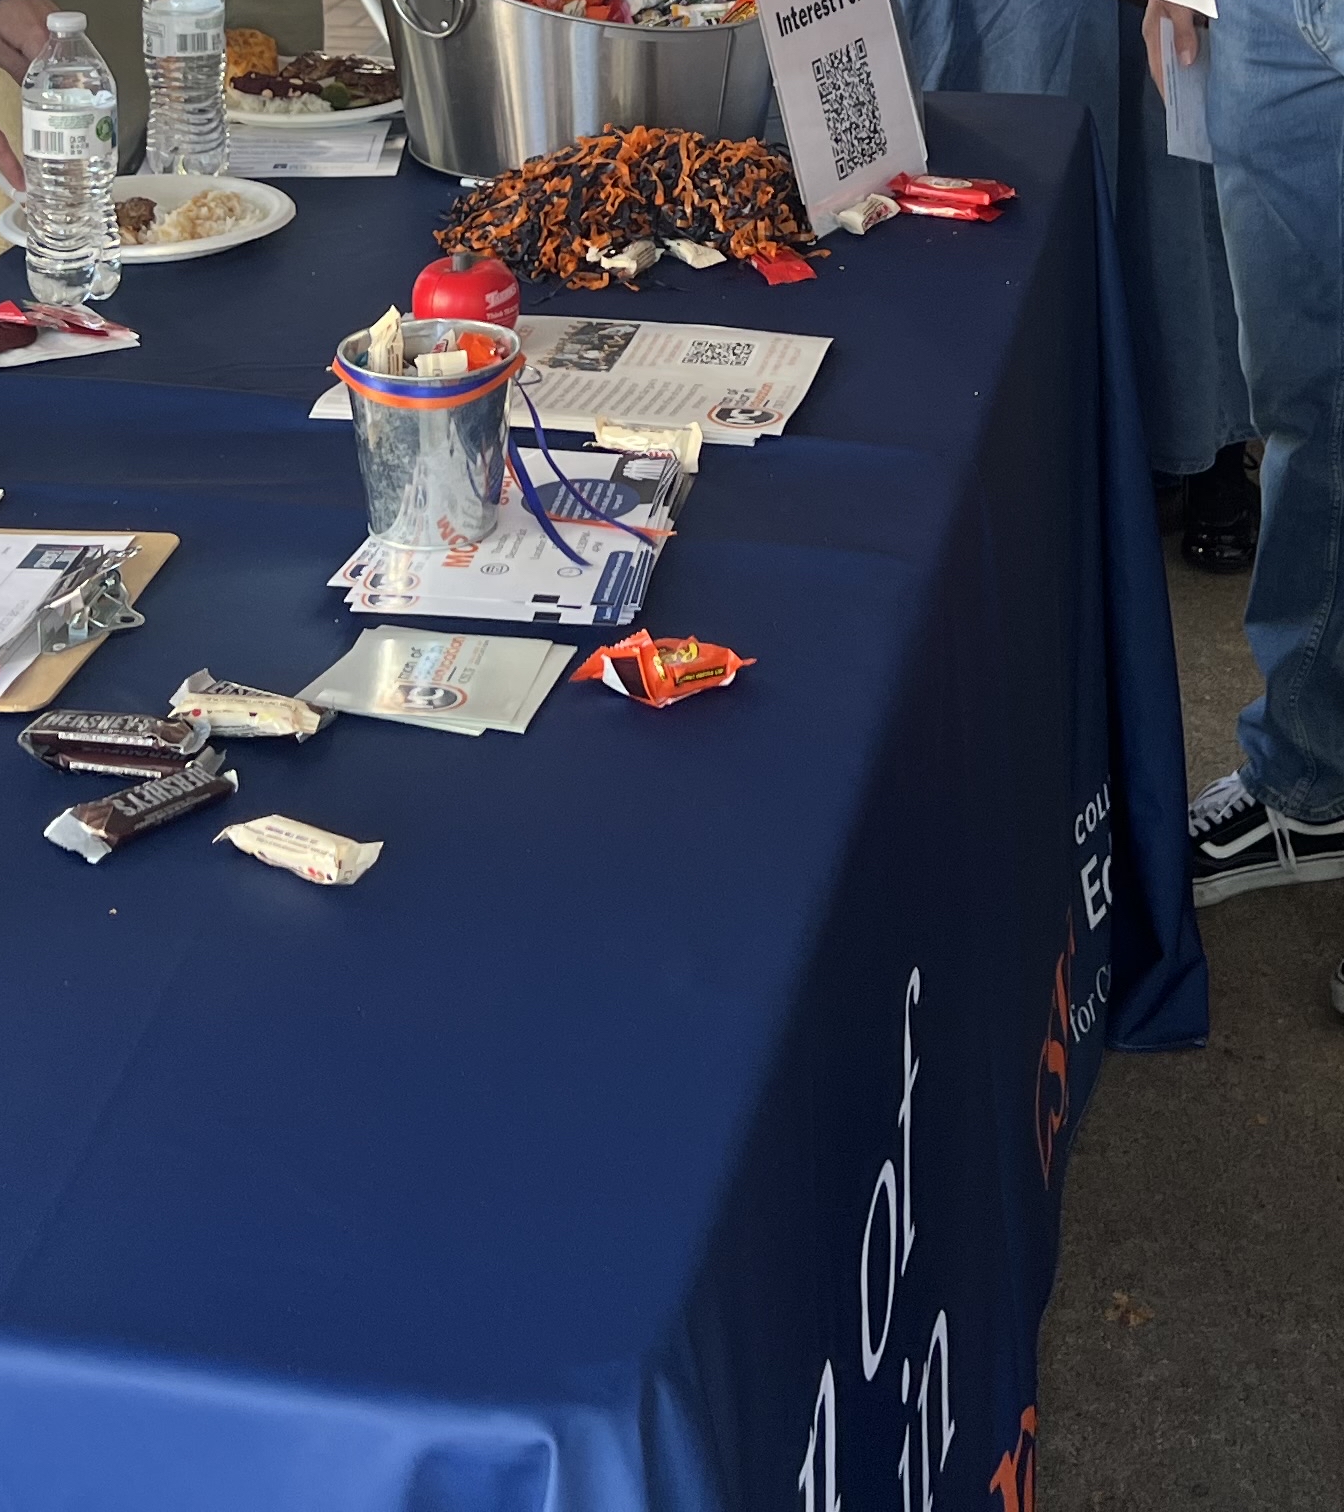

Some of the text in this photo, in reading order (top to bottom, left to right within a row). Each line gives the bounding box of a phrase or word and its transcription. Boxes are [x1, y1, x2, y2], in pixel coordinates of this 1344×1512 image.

[43, 713, 150, 733] HERSHEY'S
[1069, 992, 1096, 1043] for
[860, 966, 921, 1383] of
